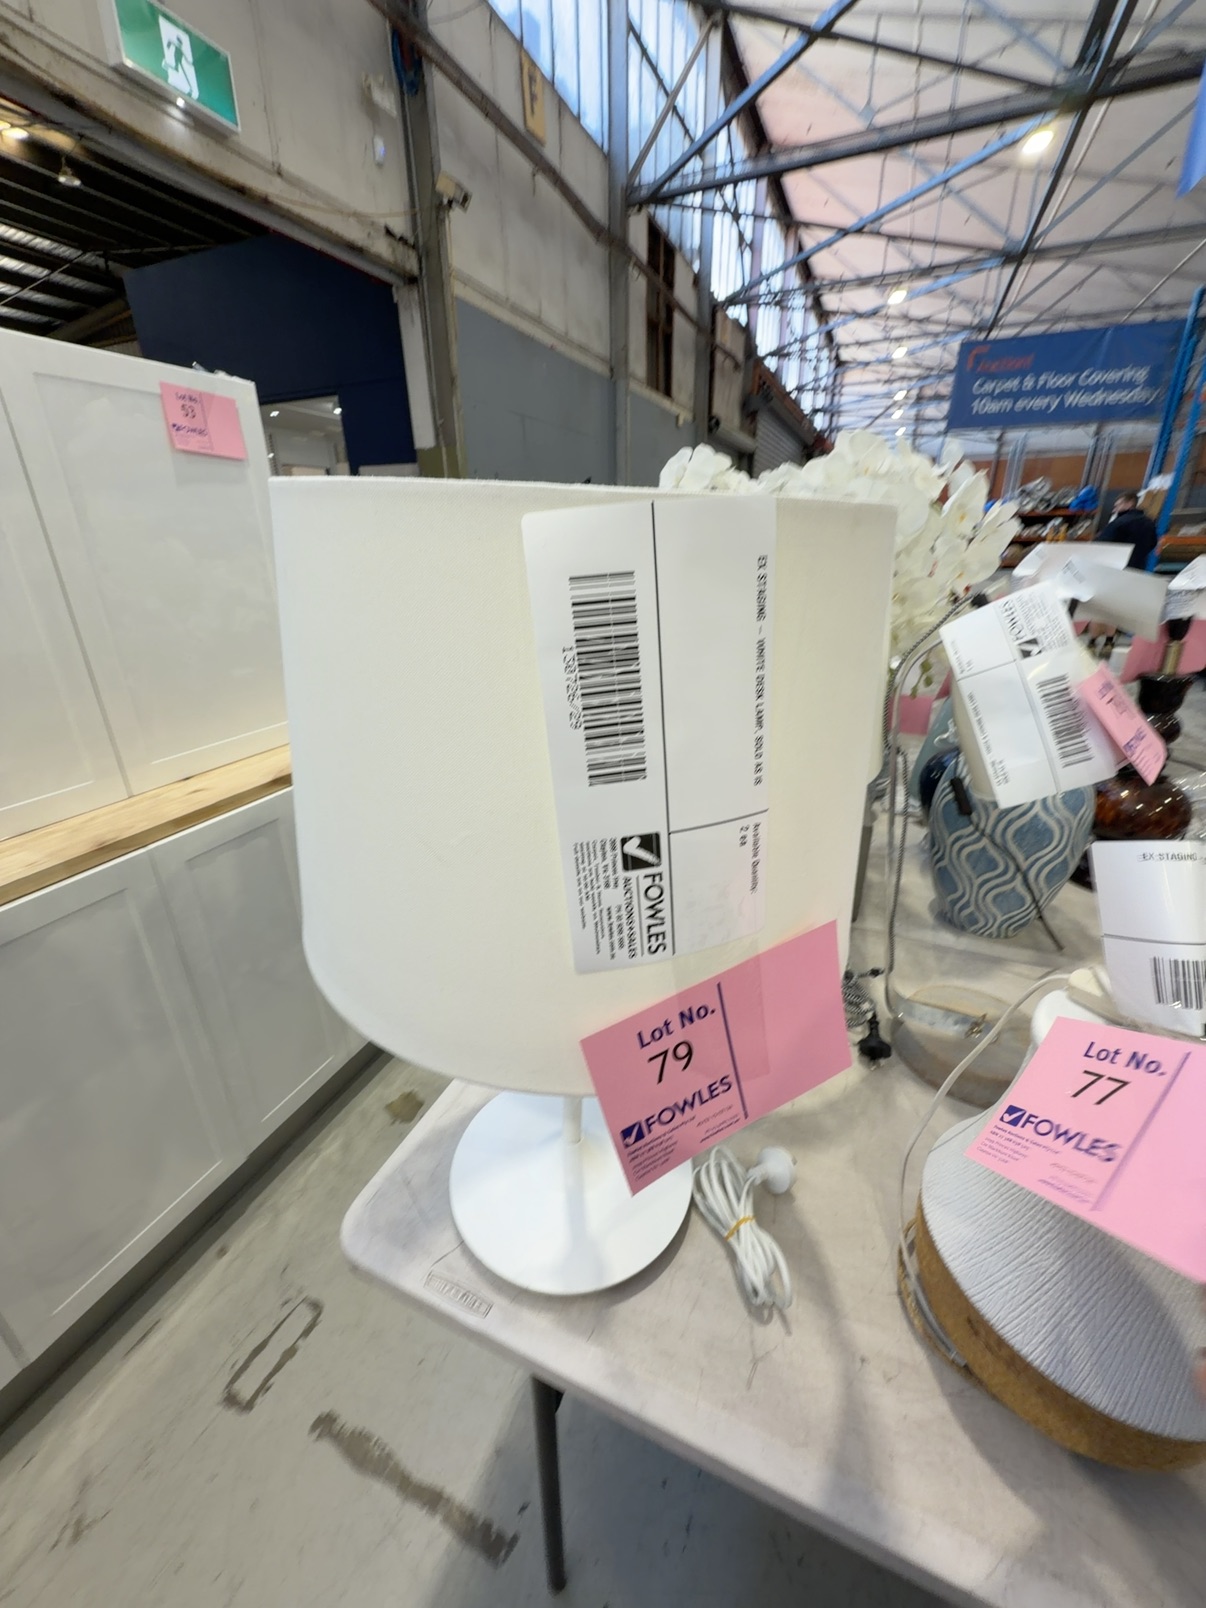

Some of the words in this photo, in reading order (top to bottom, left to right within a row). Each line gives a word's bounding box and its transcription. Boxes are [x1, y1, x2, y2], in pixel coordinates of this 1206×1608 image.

[972, 376, 1019, 397] Carpet
[1022, 375, 1034, 391] &
[1037, 370, 1076, 389] Floor
[1079, 363, 1152, 387] Covering
[971, 396, 1014, 415] 10am
[1015, 391, 1065, 414] every
[1065, 384, 1162, 409] Wednesday
[757, 554, 768, 571] EX
[755, 573, 768, 622] STAGING
[755, 637, 768, 673] WHITE
[755, 675, 767, 702] DESK
[753, 735, 766, 760] SOLD
[753, 763, 764, 776] AS
[753, 777, 763, 786] IS
[739, 825, 749, 834] 2
[1158, 851, 1198, 862] STAGING
[642, 873, 667, 956] FOWLES
[636, 1018, 674, 1049] Lot
[678, 1002, 716, 1030] No.
[647, 1040, 694, 1085] 79
[1084, 1041, 1121, 1063] Lot
[1126, 1049, 1167, 1076] No.
[1070, 1069, 1131, 1105] 77
[644, 1074, 732, 1135] FOWLES
[1020, 1112, 1121, 1163] FOWLES
